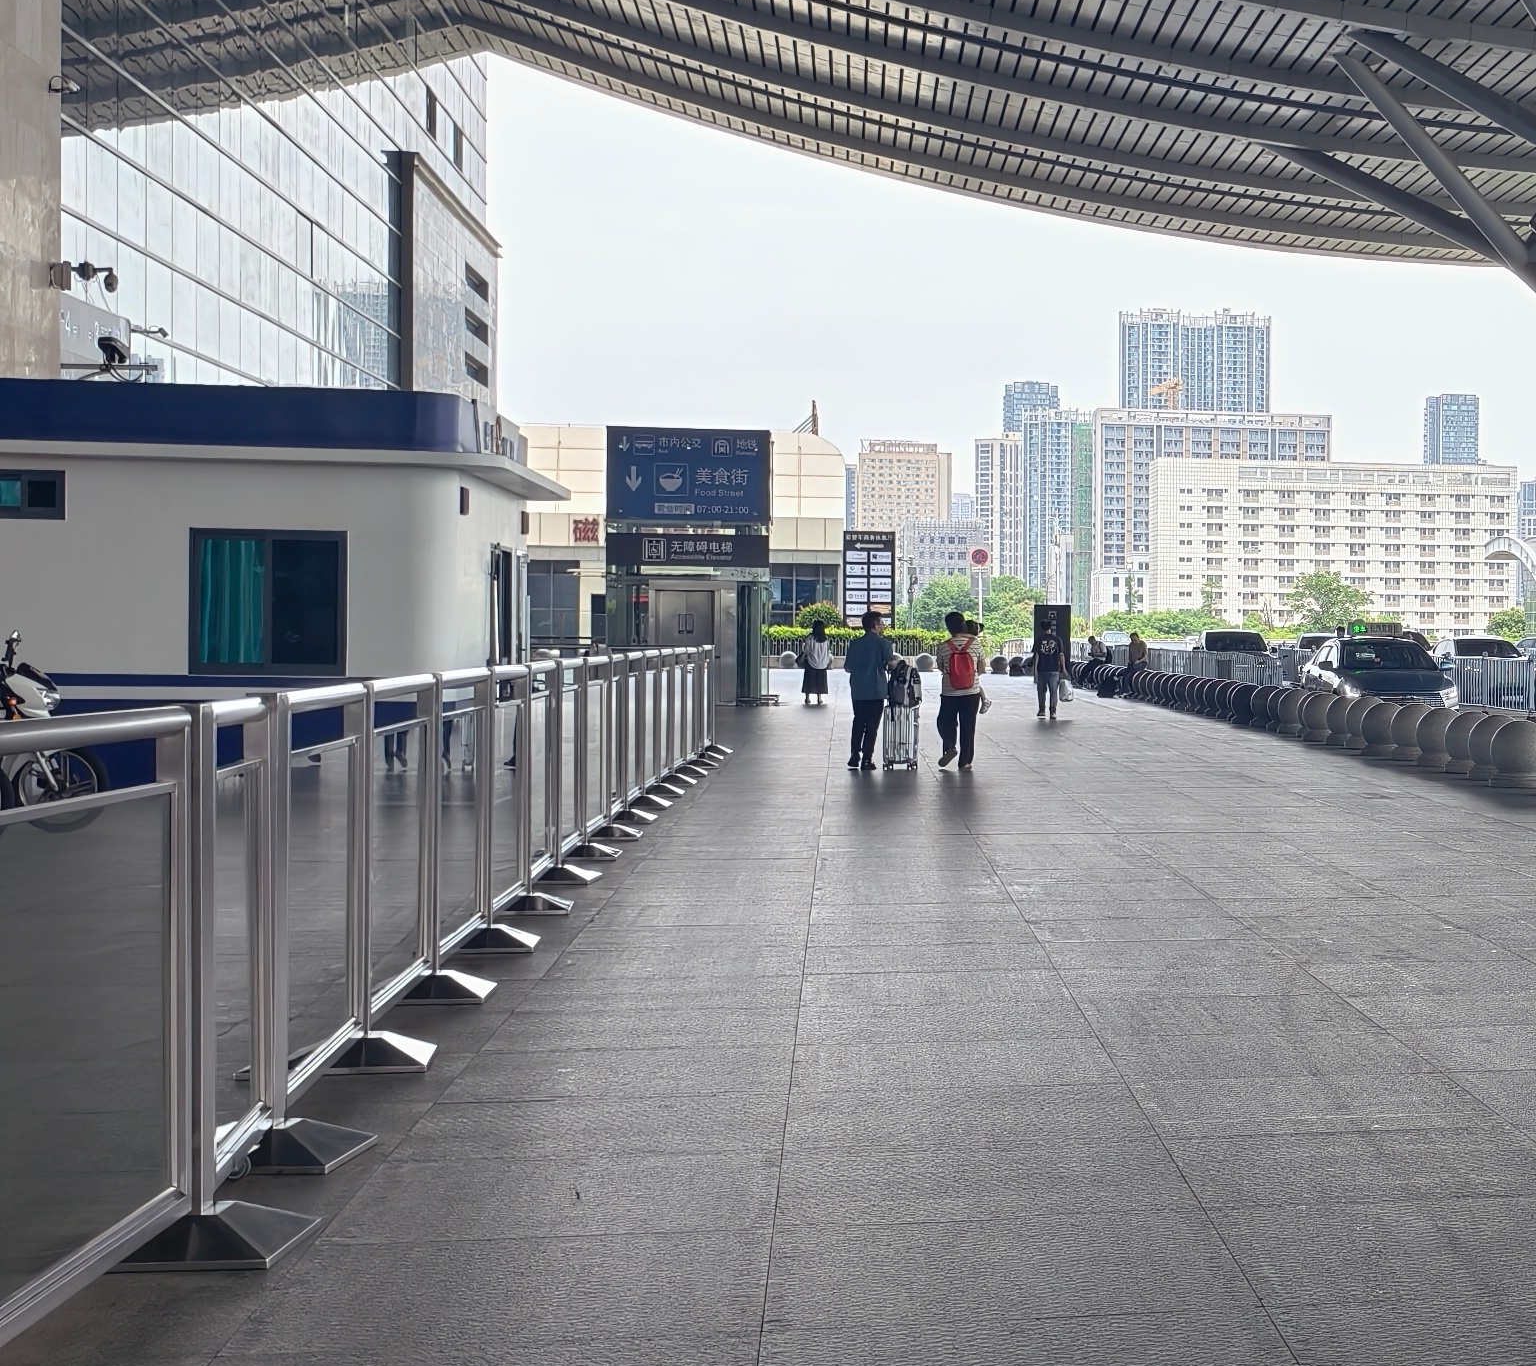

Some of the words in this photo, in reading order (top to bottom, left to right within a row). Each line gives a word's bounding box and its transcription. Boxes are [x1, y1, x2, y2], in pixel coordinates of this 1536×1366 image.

[659, 437, 702, 448] 市内公交
[736, 438, 757, 450] 地铁
[695, 467, 749, 485] 美食街
[695, 489, 717, 497] Food
[718, 489, 744, 497] Street
[697, 505, 749, 514] 07:00-21:00
[670, 540, 733, 554] 无障碍电梯
